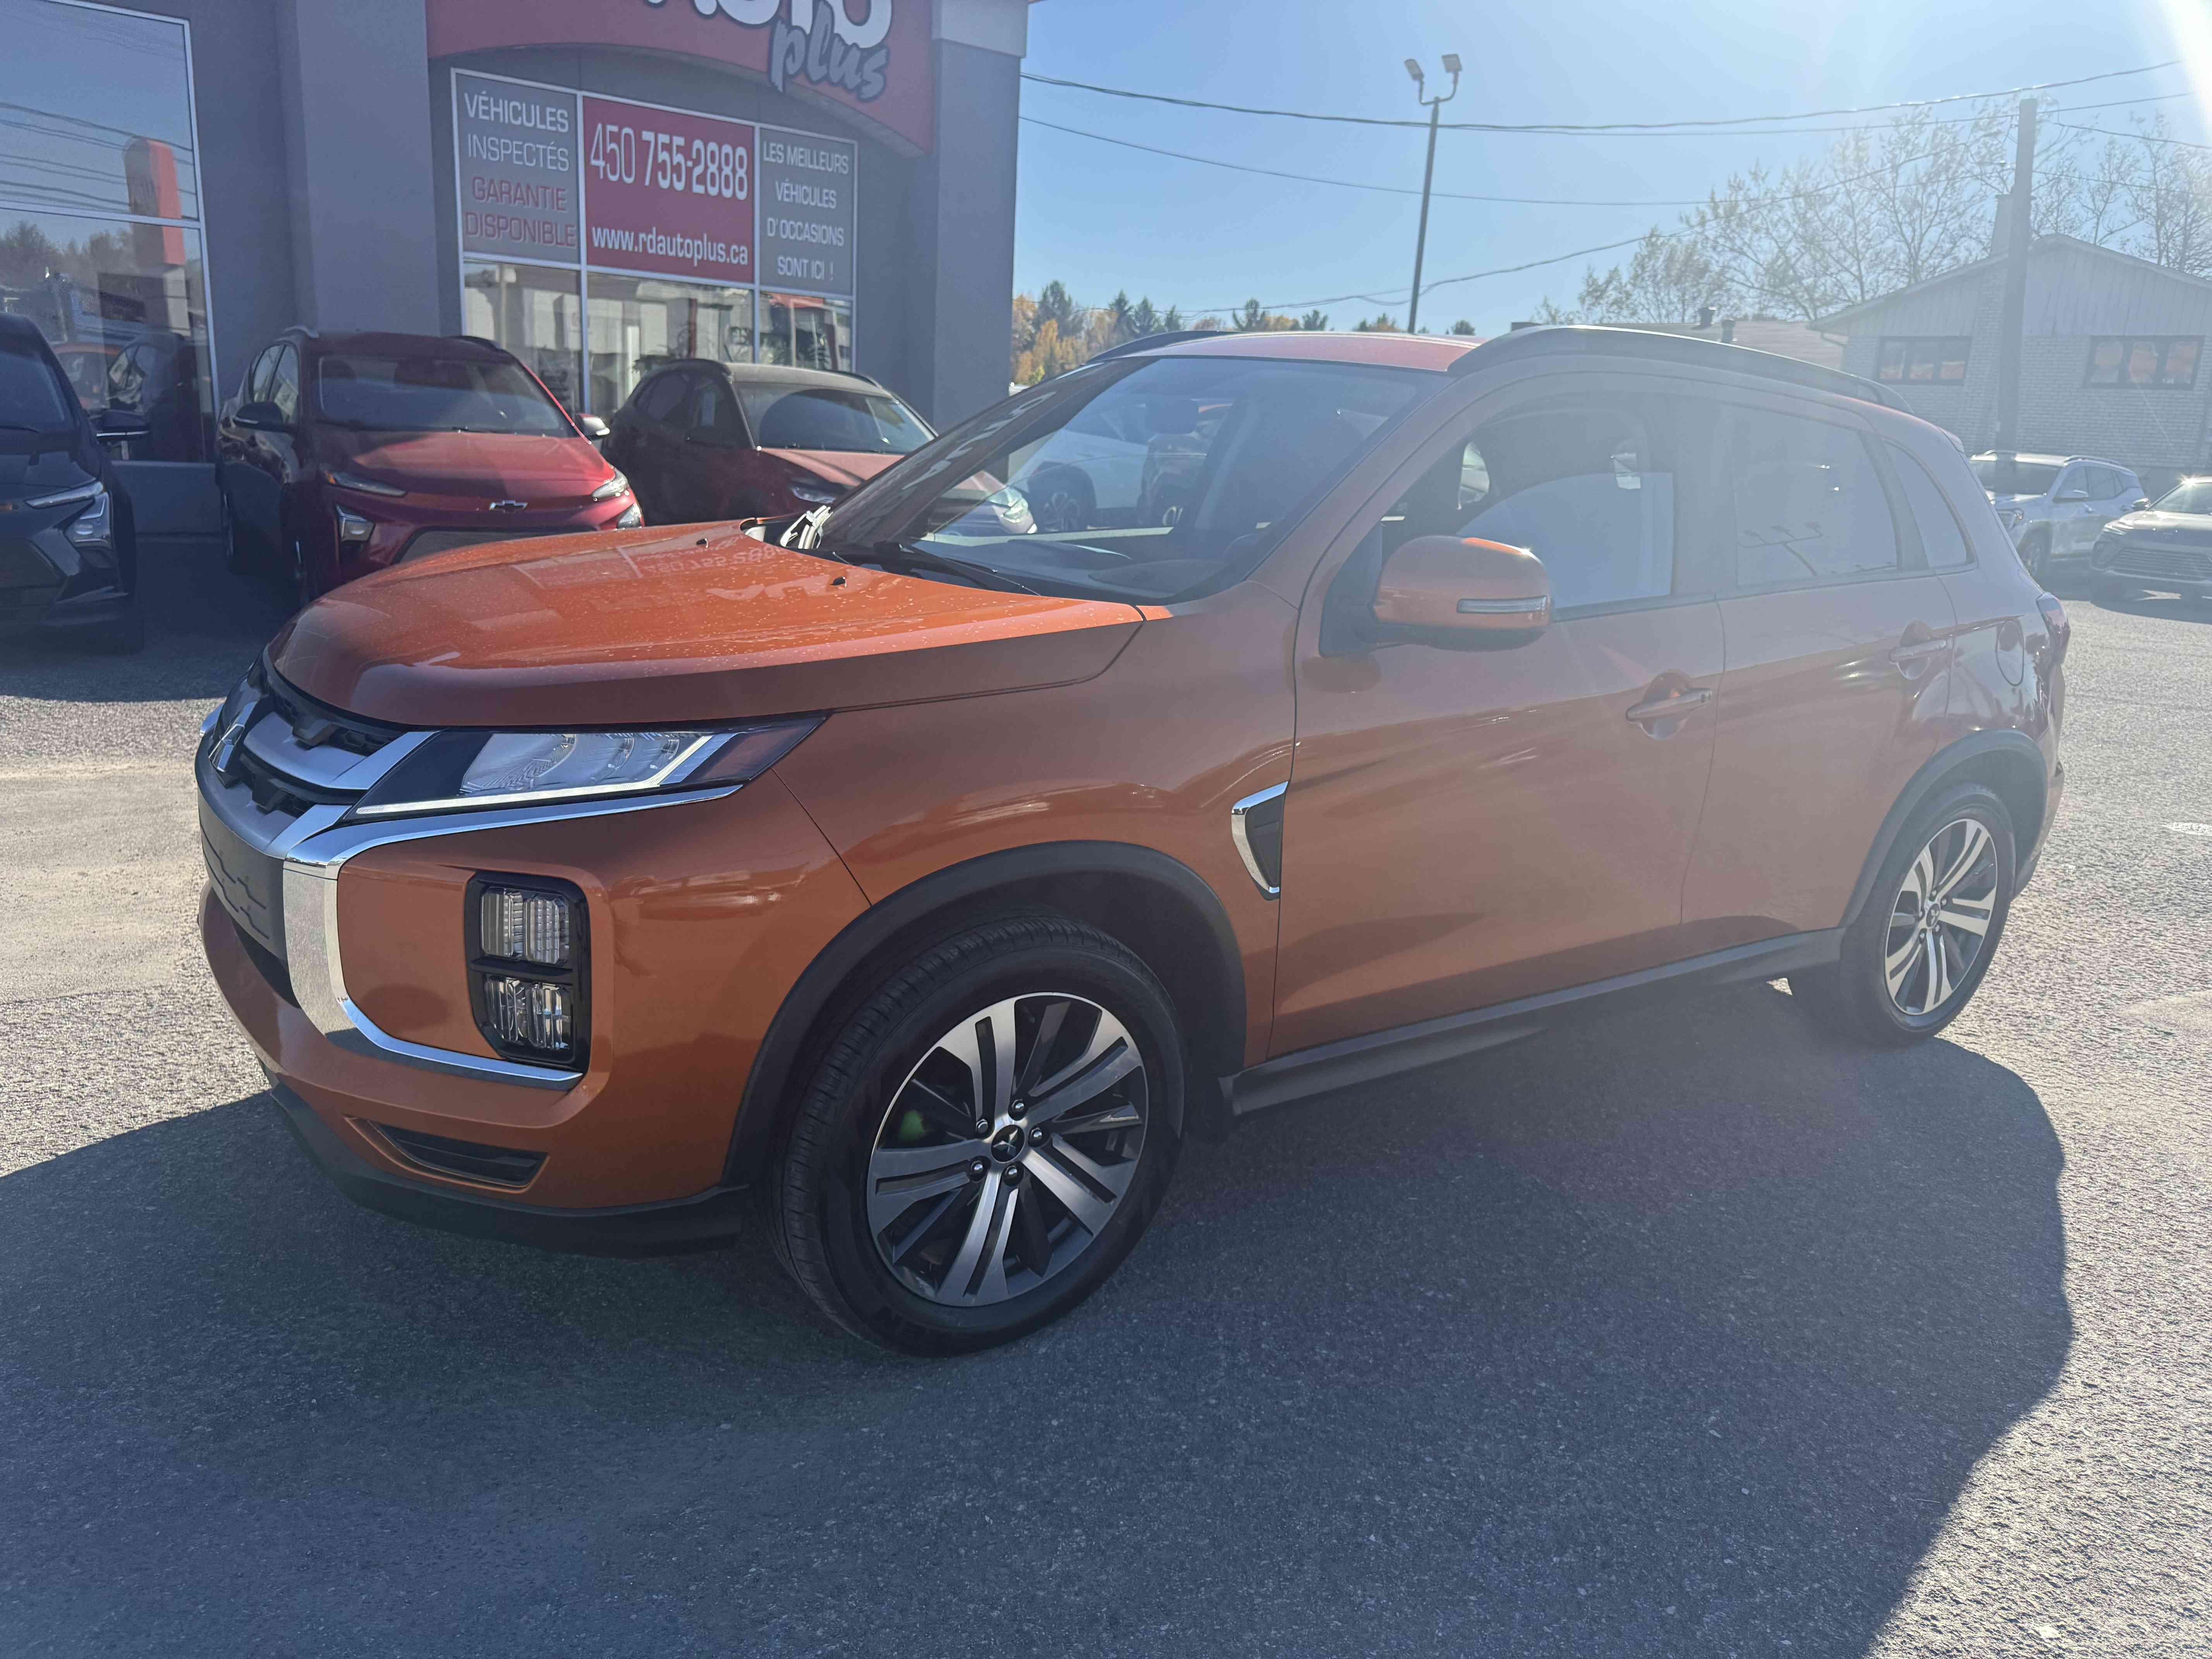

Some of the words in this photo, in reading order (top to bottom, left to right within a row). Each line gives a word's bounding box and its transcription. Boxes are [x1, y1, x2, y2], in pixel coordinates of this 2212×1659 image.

[771, 1, 889, 101] plus
[464, 91, 568, 133] VÉHICULES
[468, 133, 569, 171] INSPECTÉS
[590, 123, 635, 184] 450
[642, 130, 747, 200] 755-2888
[763, 141, 784, 163] LES
[787, 146, 848, 174] MEILLEURS
[472, 176, 567, 213] GARANTIE
[776, 177, 836, 209] VÉHICULES
[464, 212, 577, 249] DISPONIBLE
[592, 227, 748, 267] www.rdautoplus.ca
[768, 217, 844, 246] D'OCCASIONS
[778, 256, 809, 278] SONT
[811, 260, 824, 280] ICI
